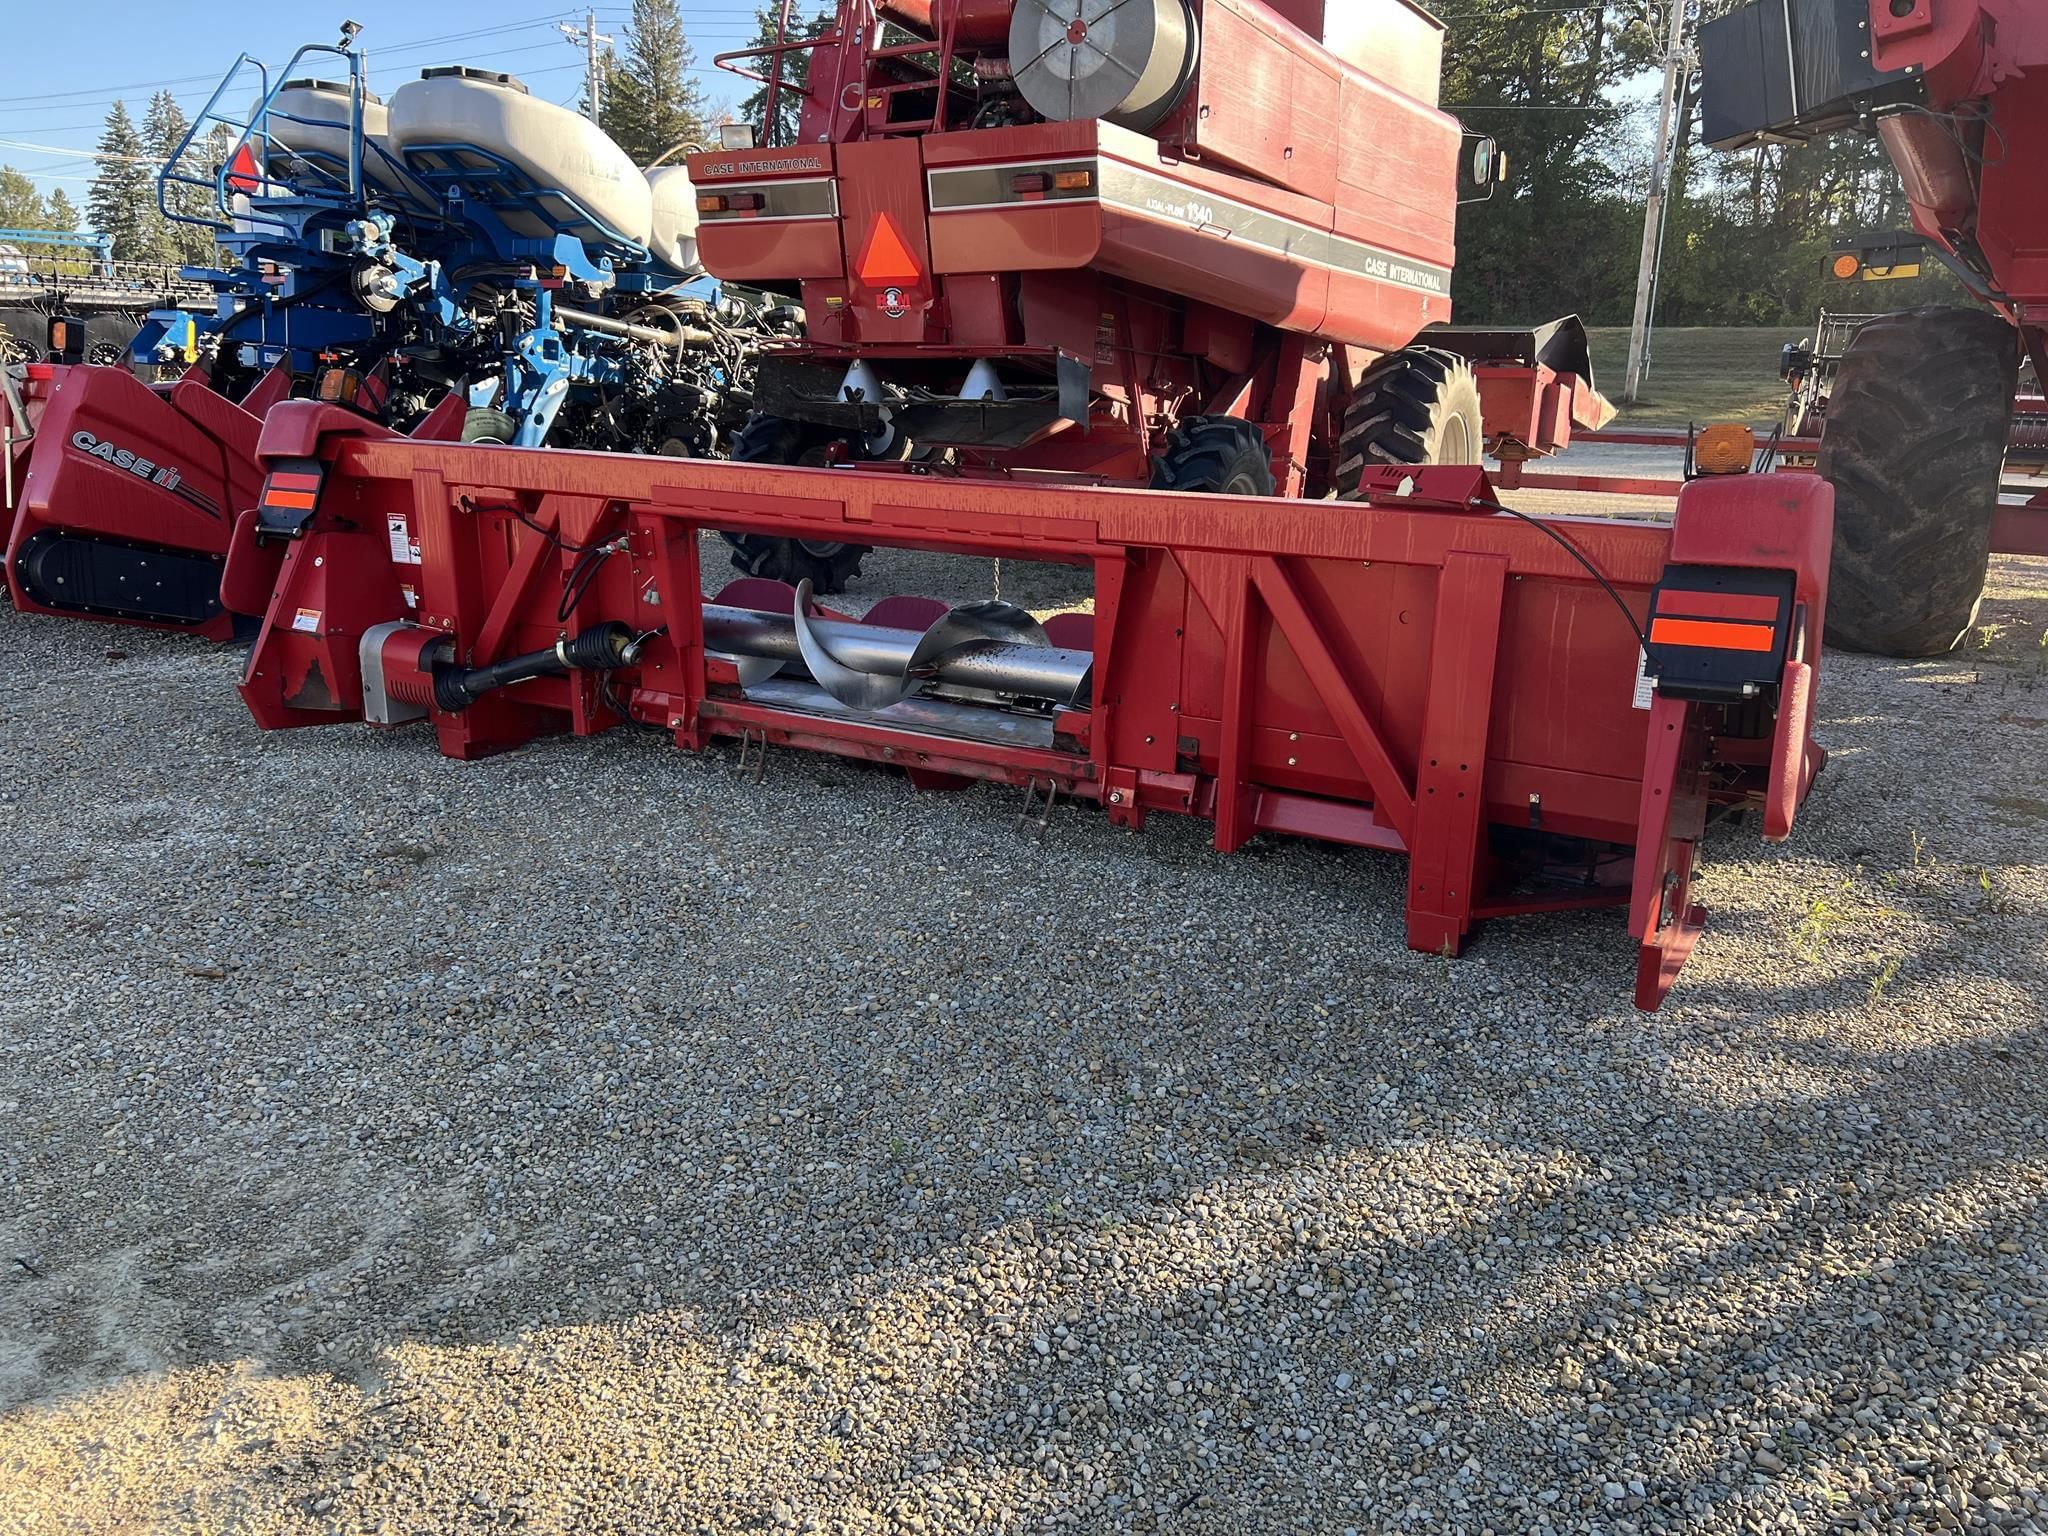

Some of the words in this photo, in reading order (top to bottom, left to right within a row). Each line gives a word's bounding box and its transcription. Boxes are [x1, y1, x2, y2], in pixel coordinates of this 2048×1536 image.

[704, 164, 734, 175] CASE
[739, 158, 821, 172] INTERNATIONAL
[1365, 257, 1387, 277] CASE
[1389, 264, 1440, 290] INTERNATIONAL
[876, 293, 911, 306] R&M
[72, 430, 155, 478] CASE
